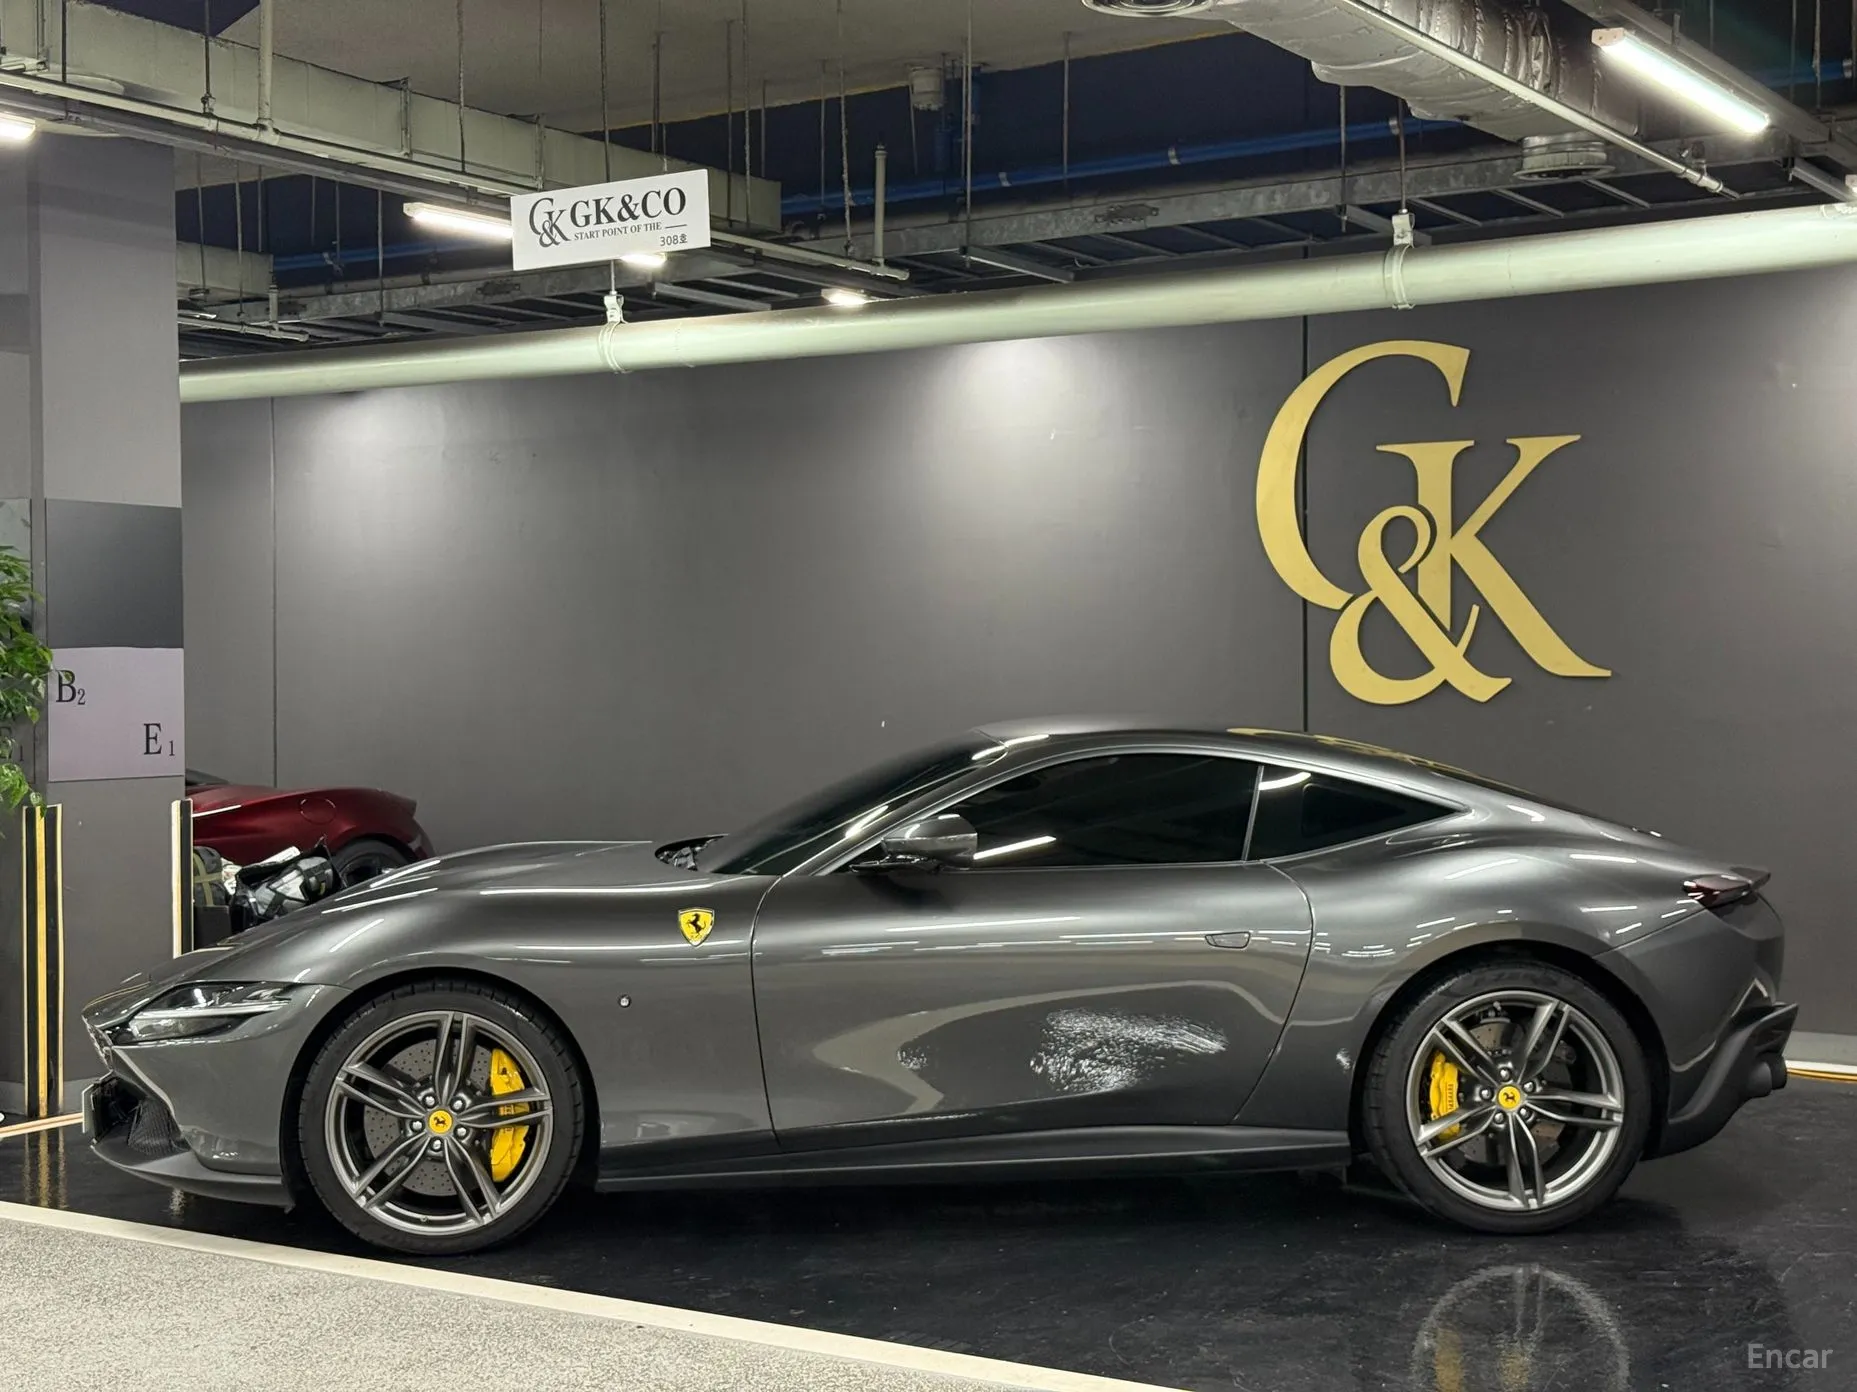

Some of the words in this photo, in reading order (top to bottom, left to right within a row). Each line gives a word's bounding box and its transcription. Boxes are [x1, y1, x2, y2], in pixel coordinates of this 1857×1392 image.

[570, 187, 686, 228] GK&CO
[574, 229, 600, 241] START
[602, 226, 629, 238] POINT
[630, 224, 642, 233] OF
[643, 222, 662, 232] THE
[659, 233, 688, 247] 308호
